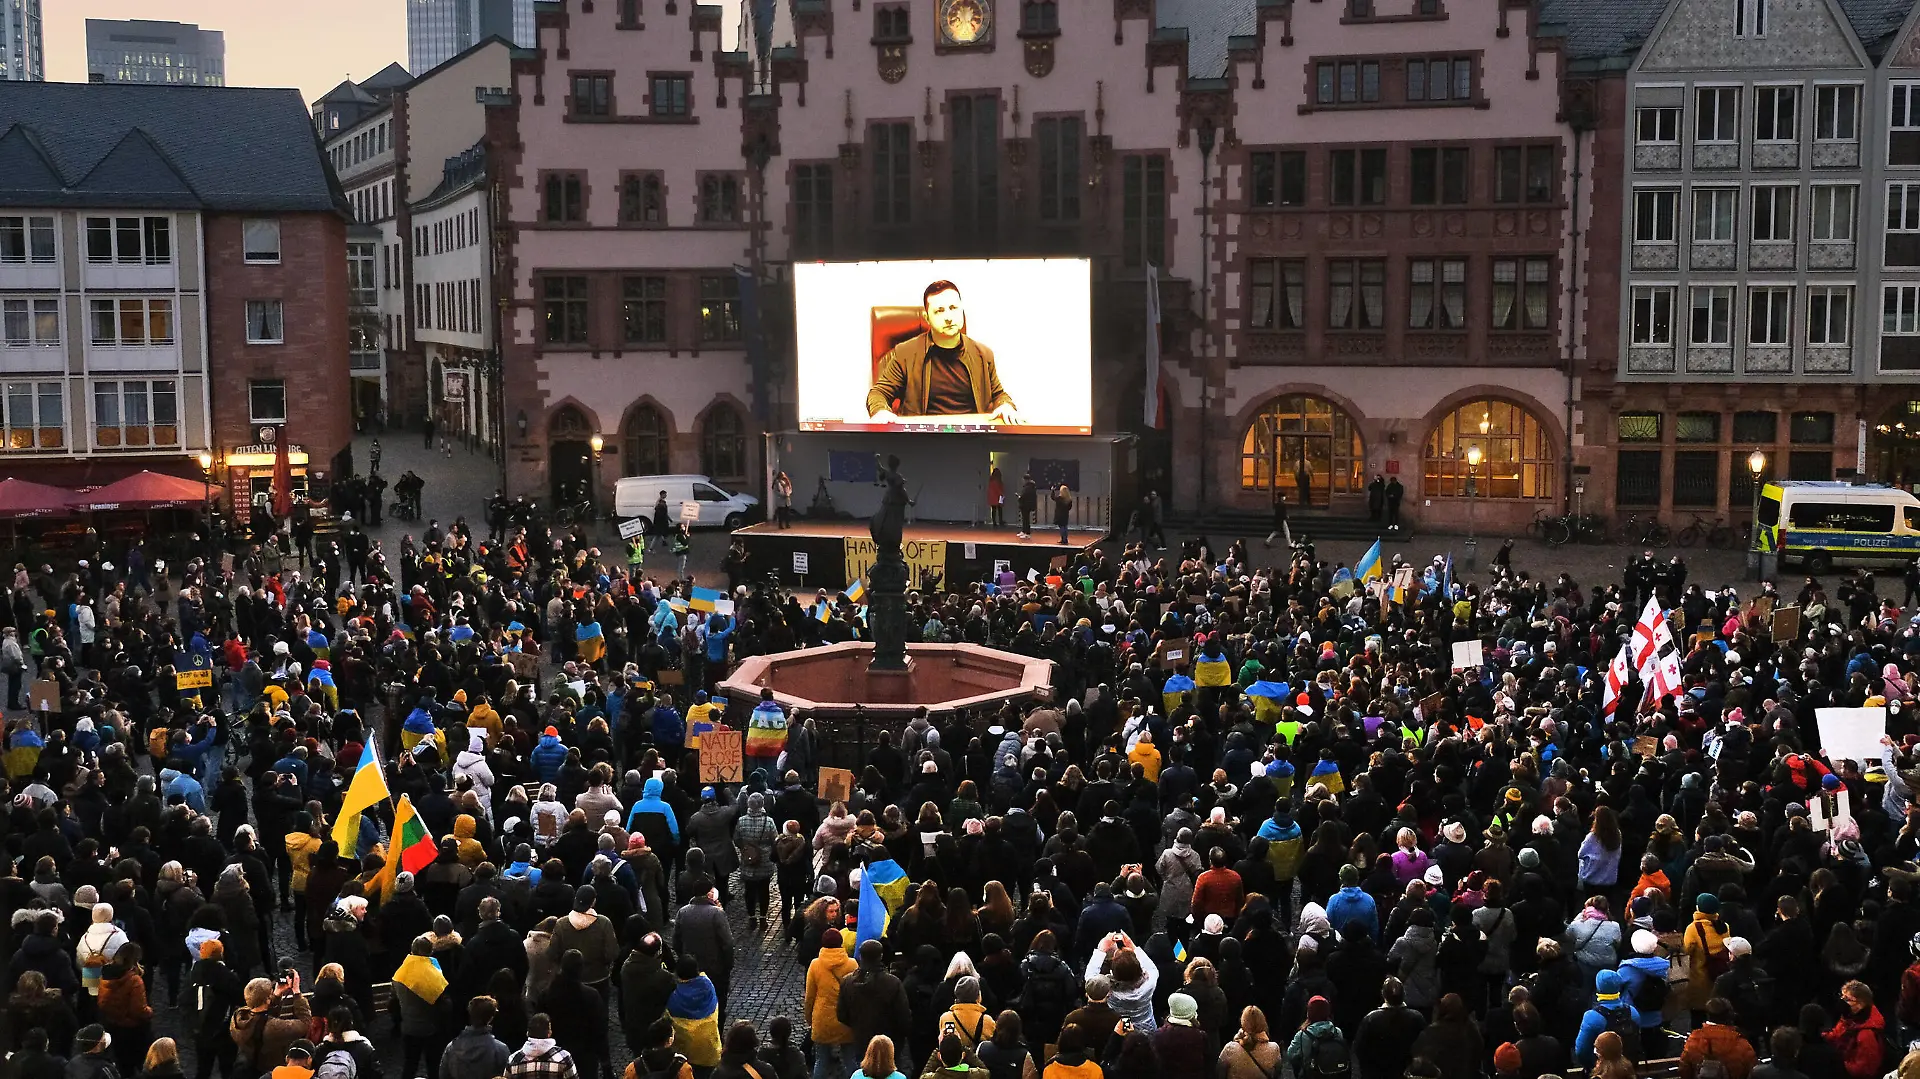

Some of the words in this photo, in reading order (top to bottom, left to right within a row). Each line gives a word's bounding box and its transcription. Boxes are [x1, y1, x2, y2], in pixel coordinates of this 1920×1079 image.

[90, 502, 120, 510] Henninger
[907, 541, 942, 560] OFF
[1853, 538, 1890, 547] POLIZEI
[701, 732, 741, 750] NATO
[700, 750, 740, 766] CLOSE
[705, 765, 739, 782] SKY
